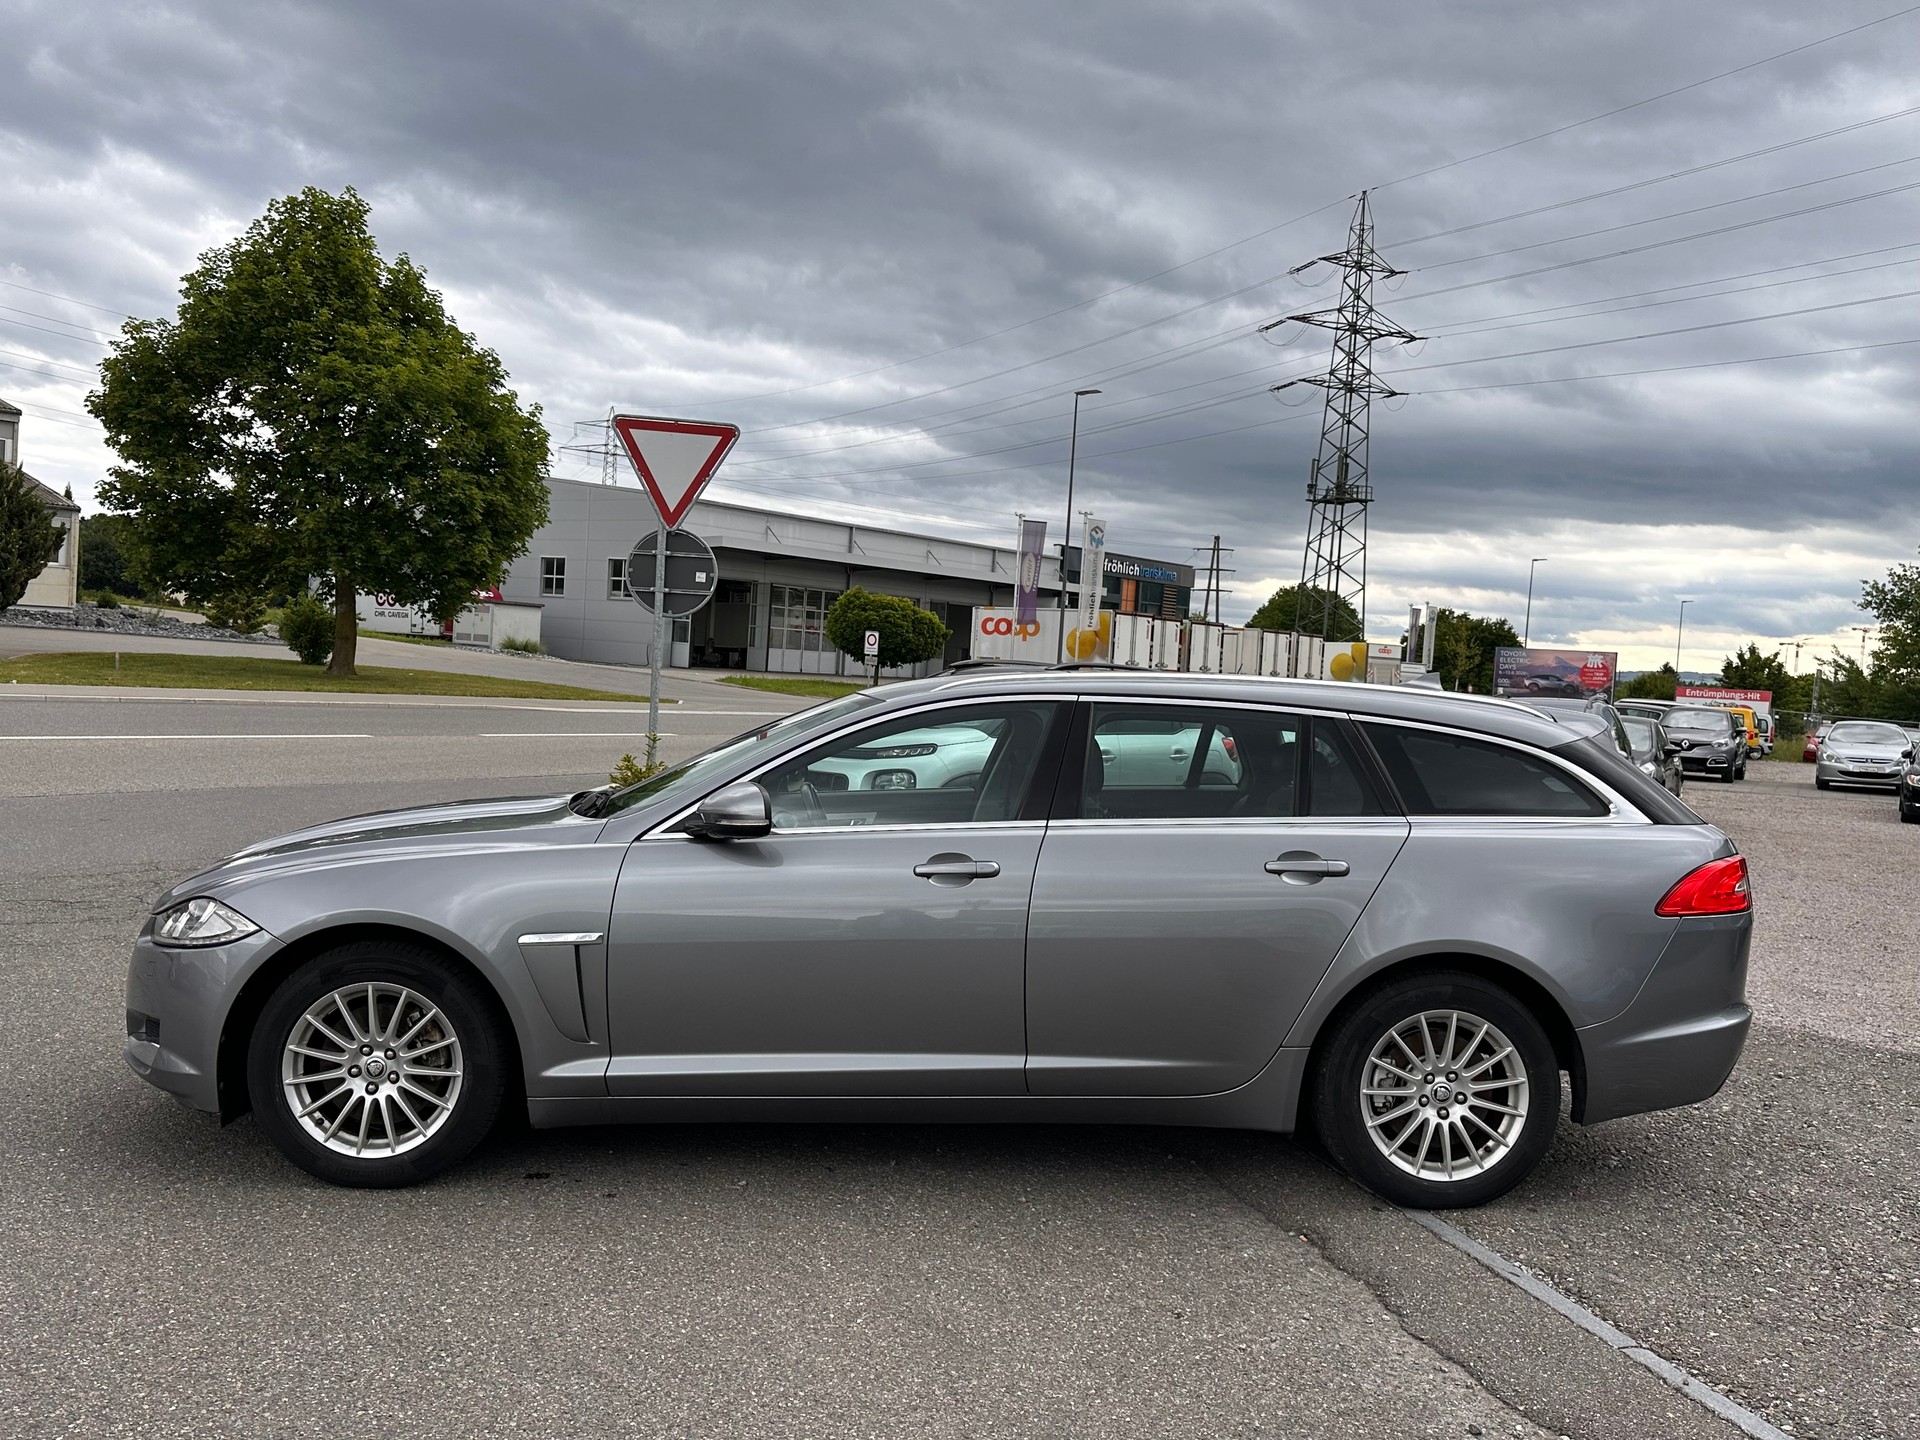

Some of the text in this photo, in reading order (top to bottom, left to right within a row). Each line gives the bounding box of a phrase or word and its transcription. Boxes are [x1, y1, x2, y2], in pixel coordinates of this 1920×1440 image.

[1025, 557, 1033, 588] Carrier
[387, 611, 409, 619] CAVEGN
[1499, 656, 1531, 664] ELECTRIC
[1685, 688, 1761, 700] Entrümplungs-Hit
